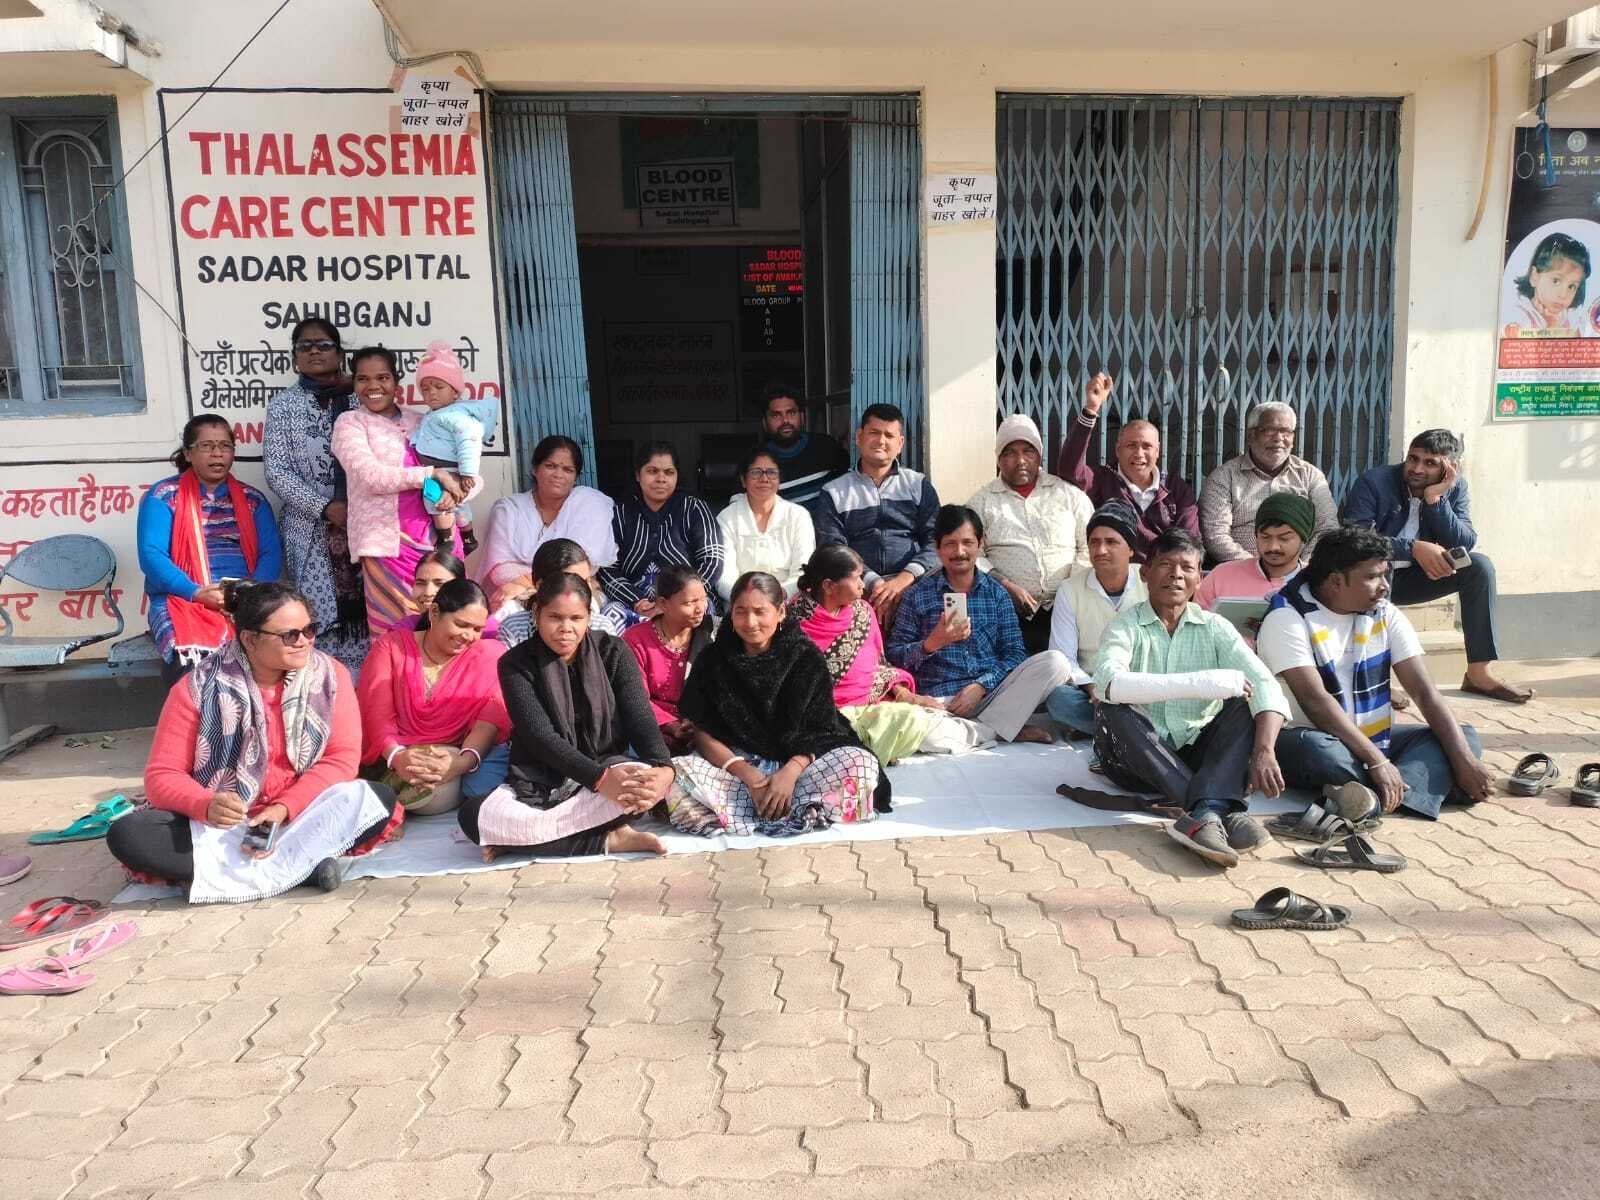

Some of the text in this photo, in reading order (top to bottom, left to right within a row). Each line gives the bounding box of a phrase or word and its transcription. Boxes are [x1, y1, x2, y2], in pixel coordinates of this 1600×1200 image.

[401, 115, 429, 126] बाहर
[189, 132, 477, 177] THALASSEMIA
[647, 169, 723, 185] BLOOD
[642, 187, 730, 204] CENTRE
[180, 194, 476, 240] CARE CENTRE
[767, 249, 801, 261] BLOOD
[198, 253, 470, 283] SADAR HOSPITAL
[755, 284, 777, 293] DATE
[743, 297, 766, 305] OOD
[768, 297, 791, 305] GROUP
[262, 301, 431, 329] SAHIBGANJ
[200, 340, 236, 376] यहाँ
[236, 339, 291, 376] प्रत्येक
